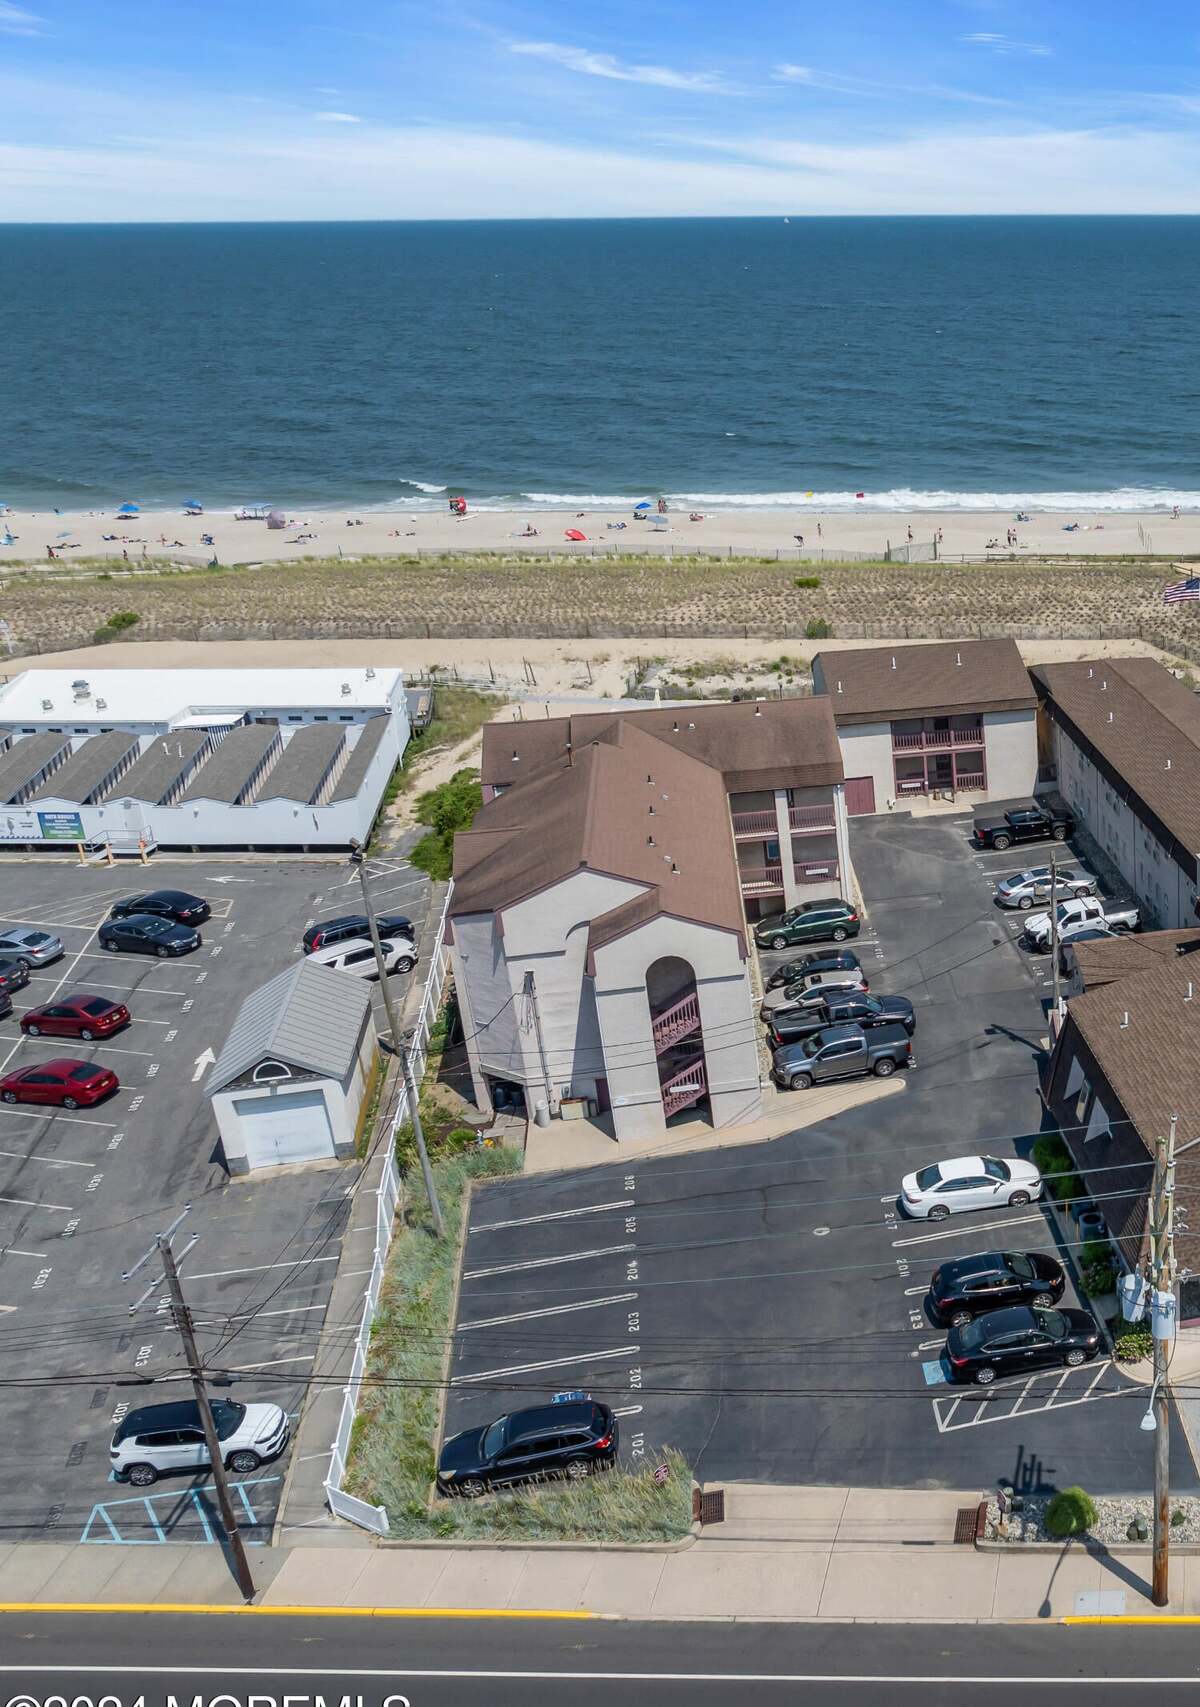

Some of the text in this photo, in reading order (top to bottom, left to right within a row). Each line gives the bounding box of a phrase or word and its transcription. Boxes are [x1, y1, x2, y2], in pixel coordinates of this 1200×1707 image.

[61, 1218, 80, 1236] 1031
[625, 1216, 636, 1233] 205
[31, 1267, 53, 1289] 1032
[627, 1260, 638, 1281] 204
[628, 1311, 640, 1332] 203
[908, 1308, 924, 1330] 123
[135, 1345, 153, 1368] 1013
[629, 1366, 642, 1389] 202
[631, 1431, 644, 1458] 201
